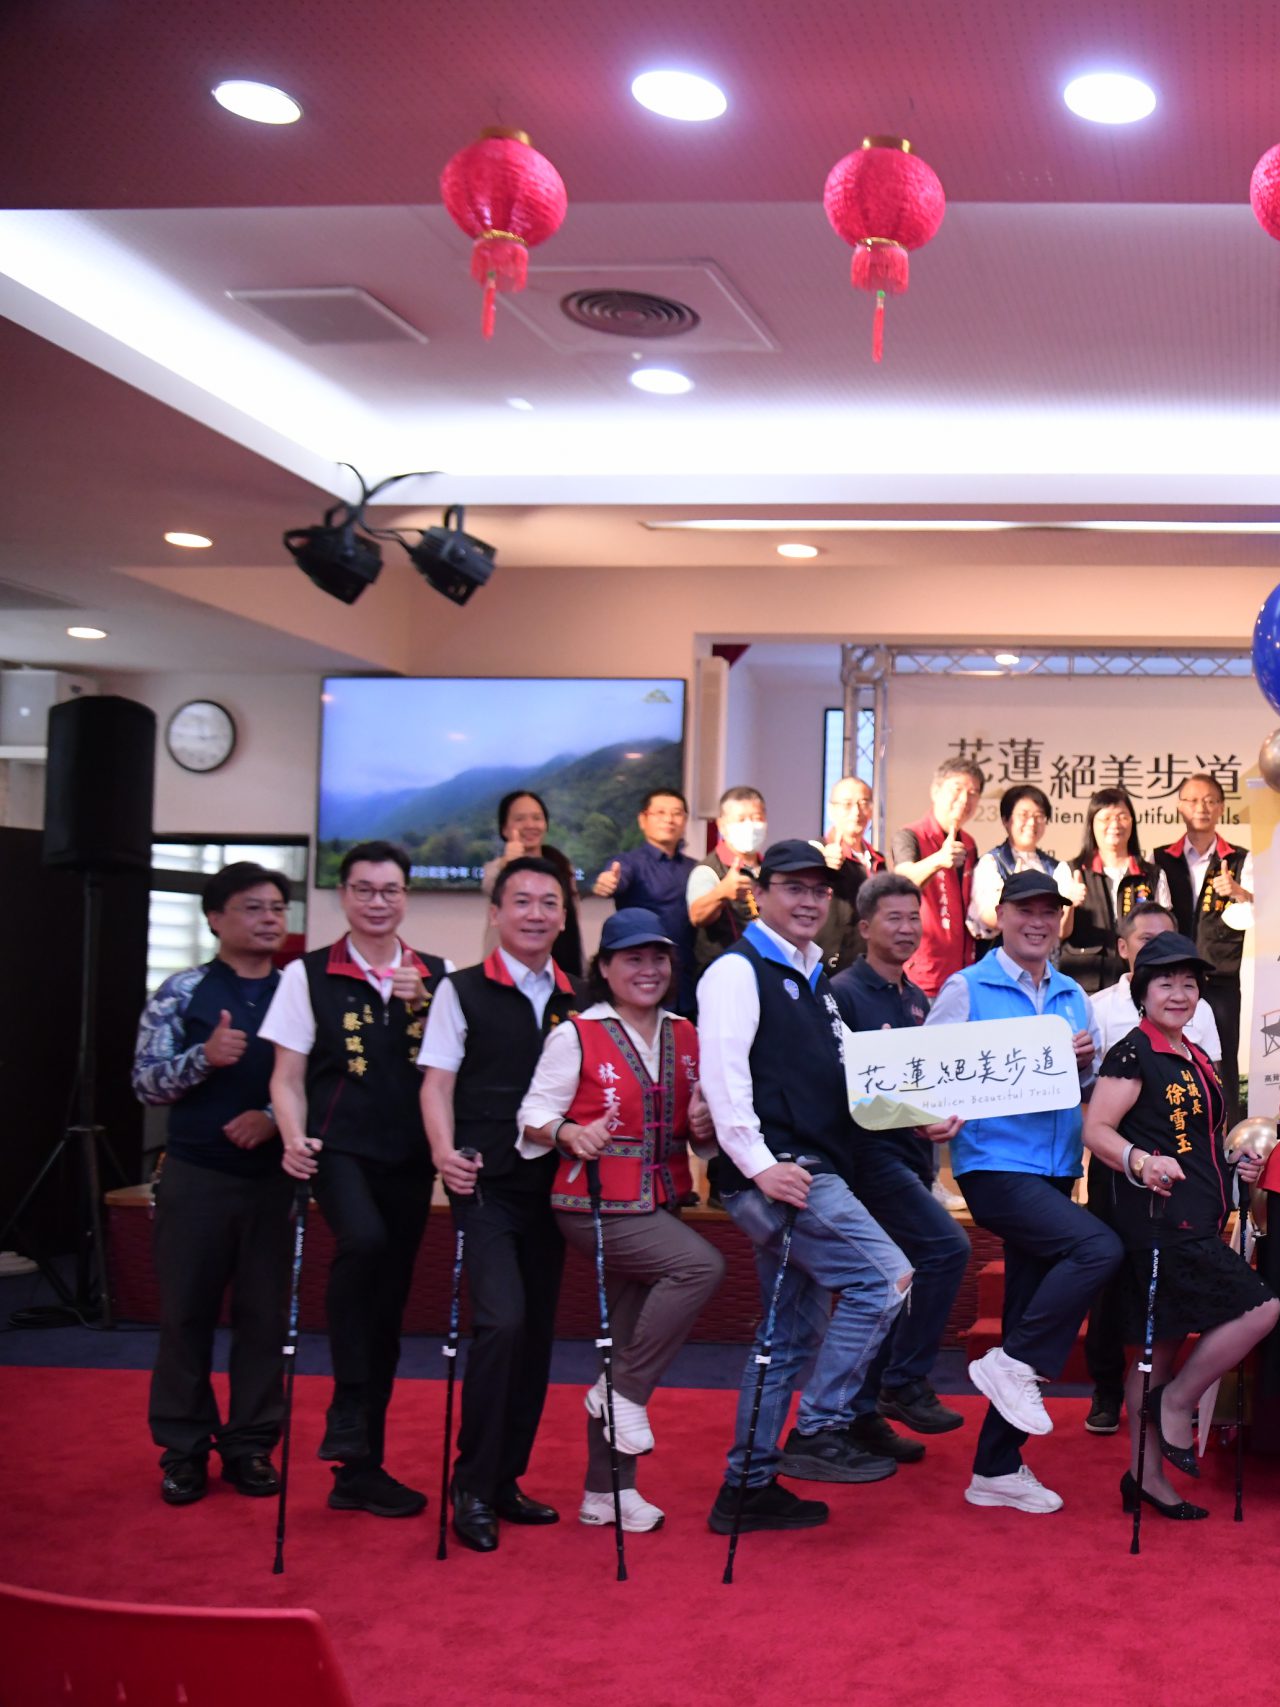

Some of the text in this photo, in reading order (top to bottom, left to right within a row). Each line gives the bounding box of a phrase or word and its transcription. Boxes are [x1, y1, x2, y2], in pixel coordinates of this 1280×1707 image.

[858, 1046, 1067, 1094] 花蓮絕美步道
[1166, 1083, 1193, 1154] 徐雪玉
